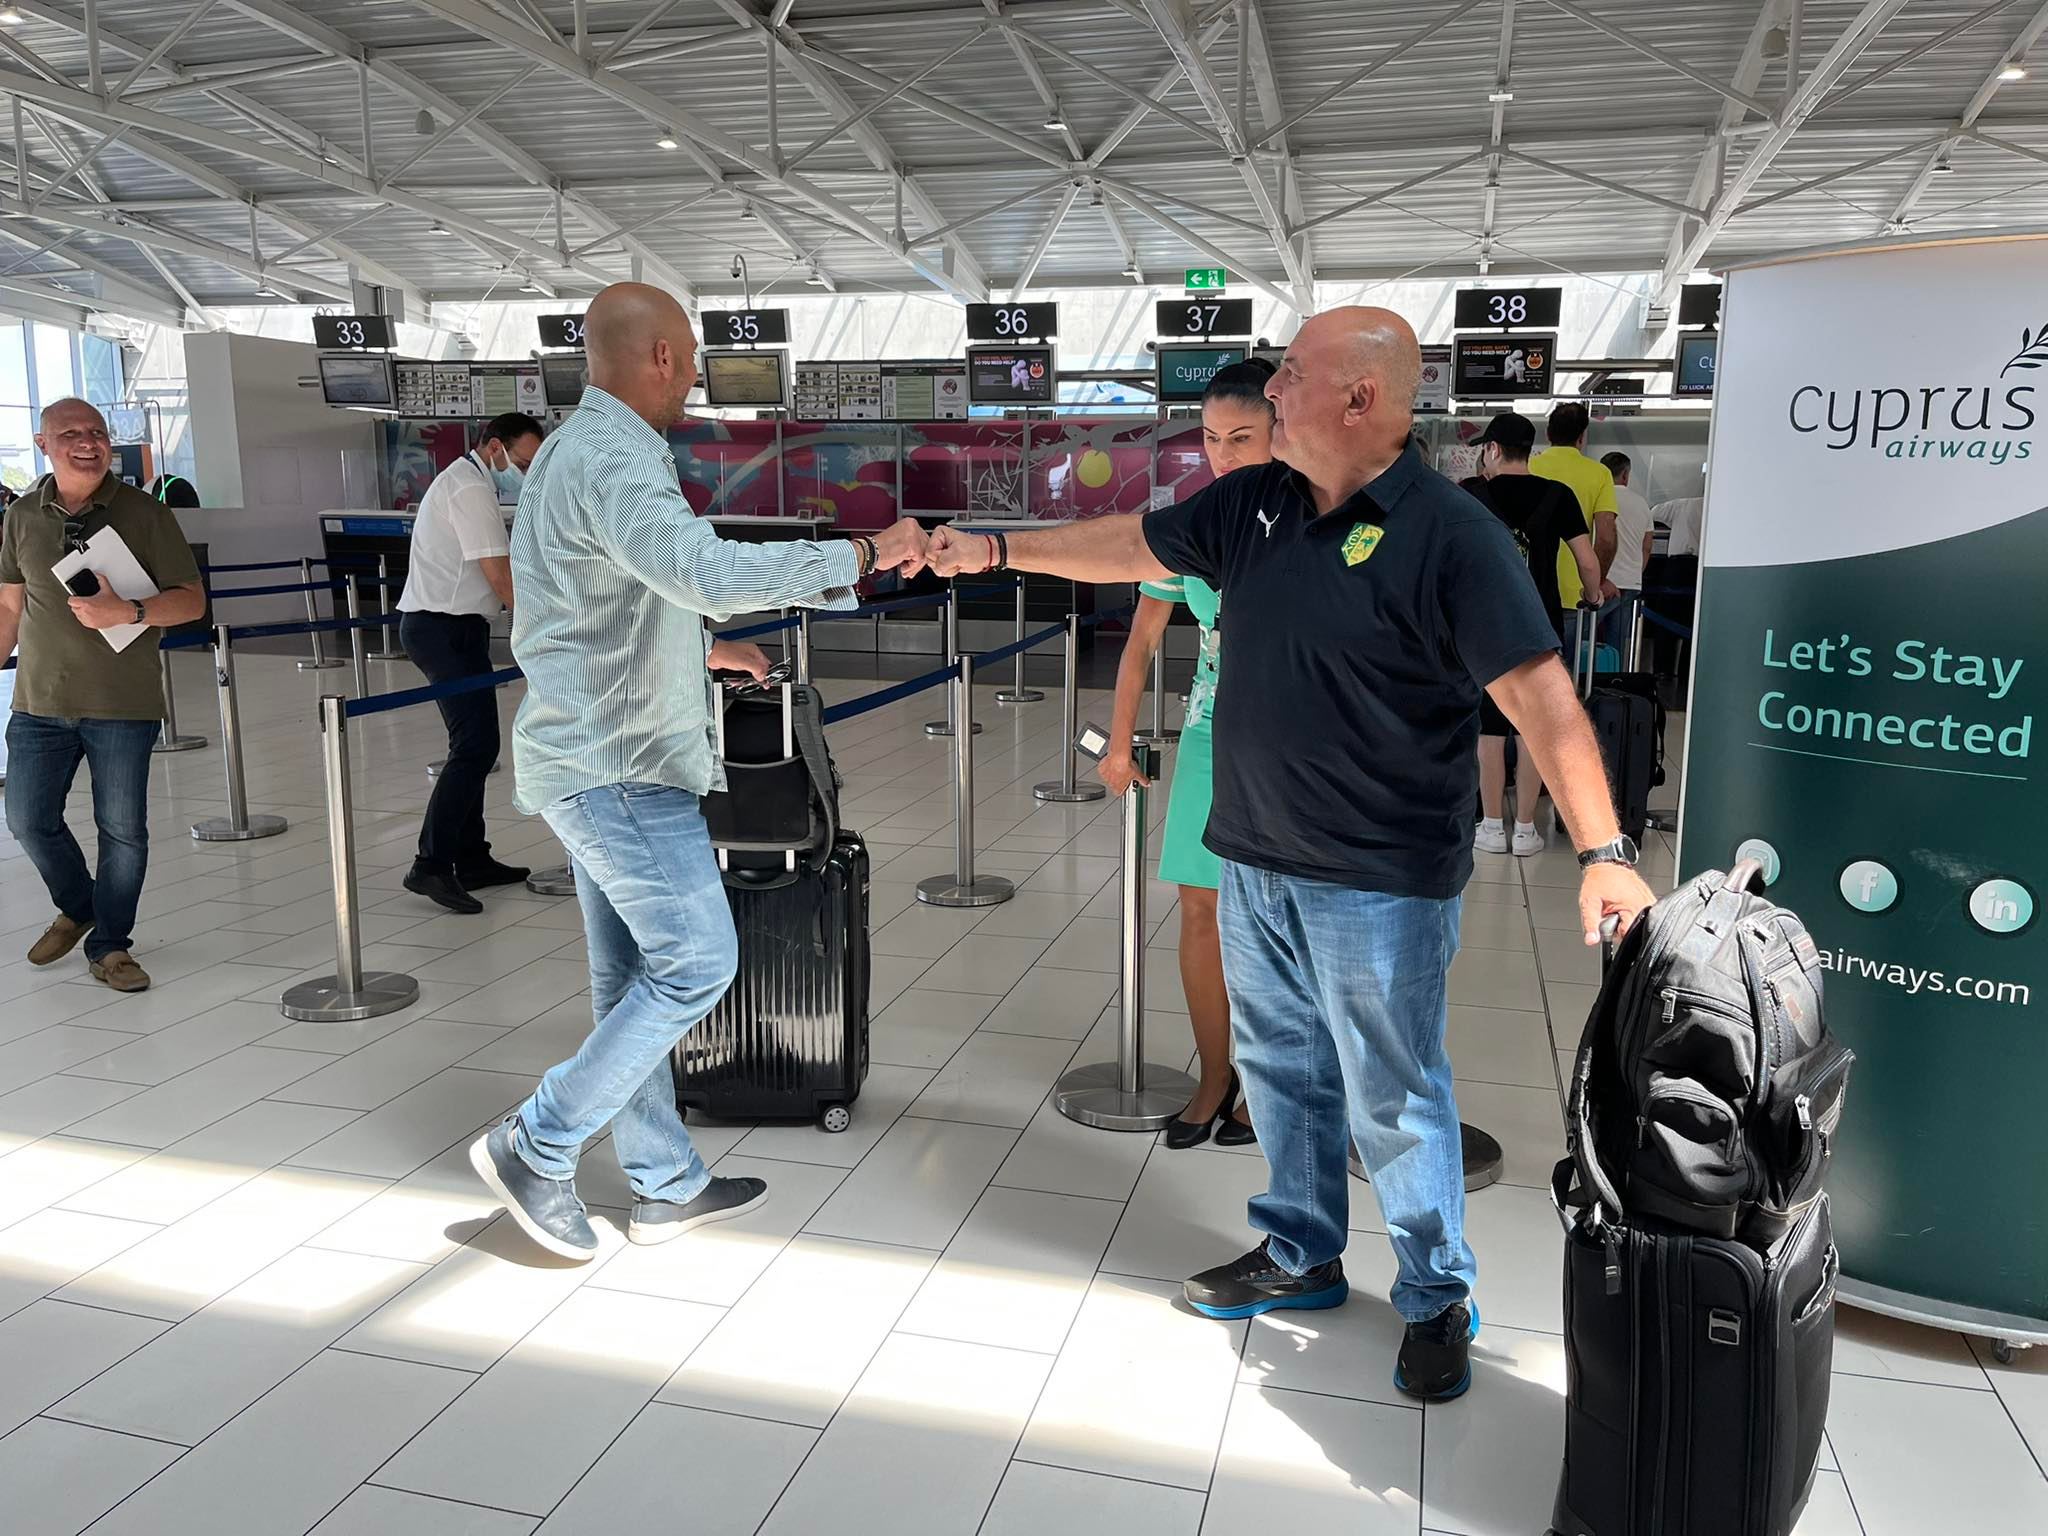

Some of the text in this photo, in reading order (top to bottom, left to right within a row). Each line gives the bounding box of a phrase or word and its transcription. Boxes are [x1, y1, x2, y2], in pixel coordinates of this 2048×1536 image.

[994, 308, 1028, 335] 36
[1186, 305, 1222, 332] 37
[1487, 295, 1527, 323] 38
[336, 321, 365, 344] 33
[728, 315, 759, 340] 35
[1176, 366, 1223, 382] cypru
[1885, 435, 2033, 465] airways
[1892, 640, 2024, 699] Stay
[1758, 691, 2033, 758] Connected
[1985, 889, 2019, 922] in
